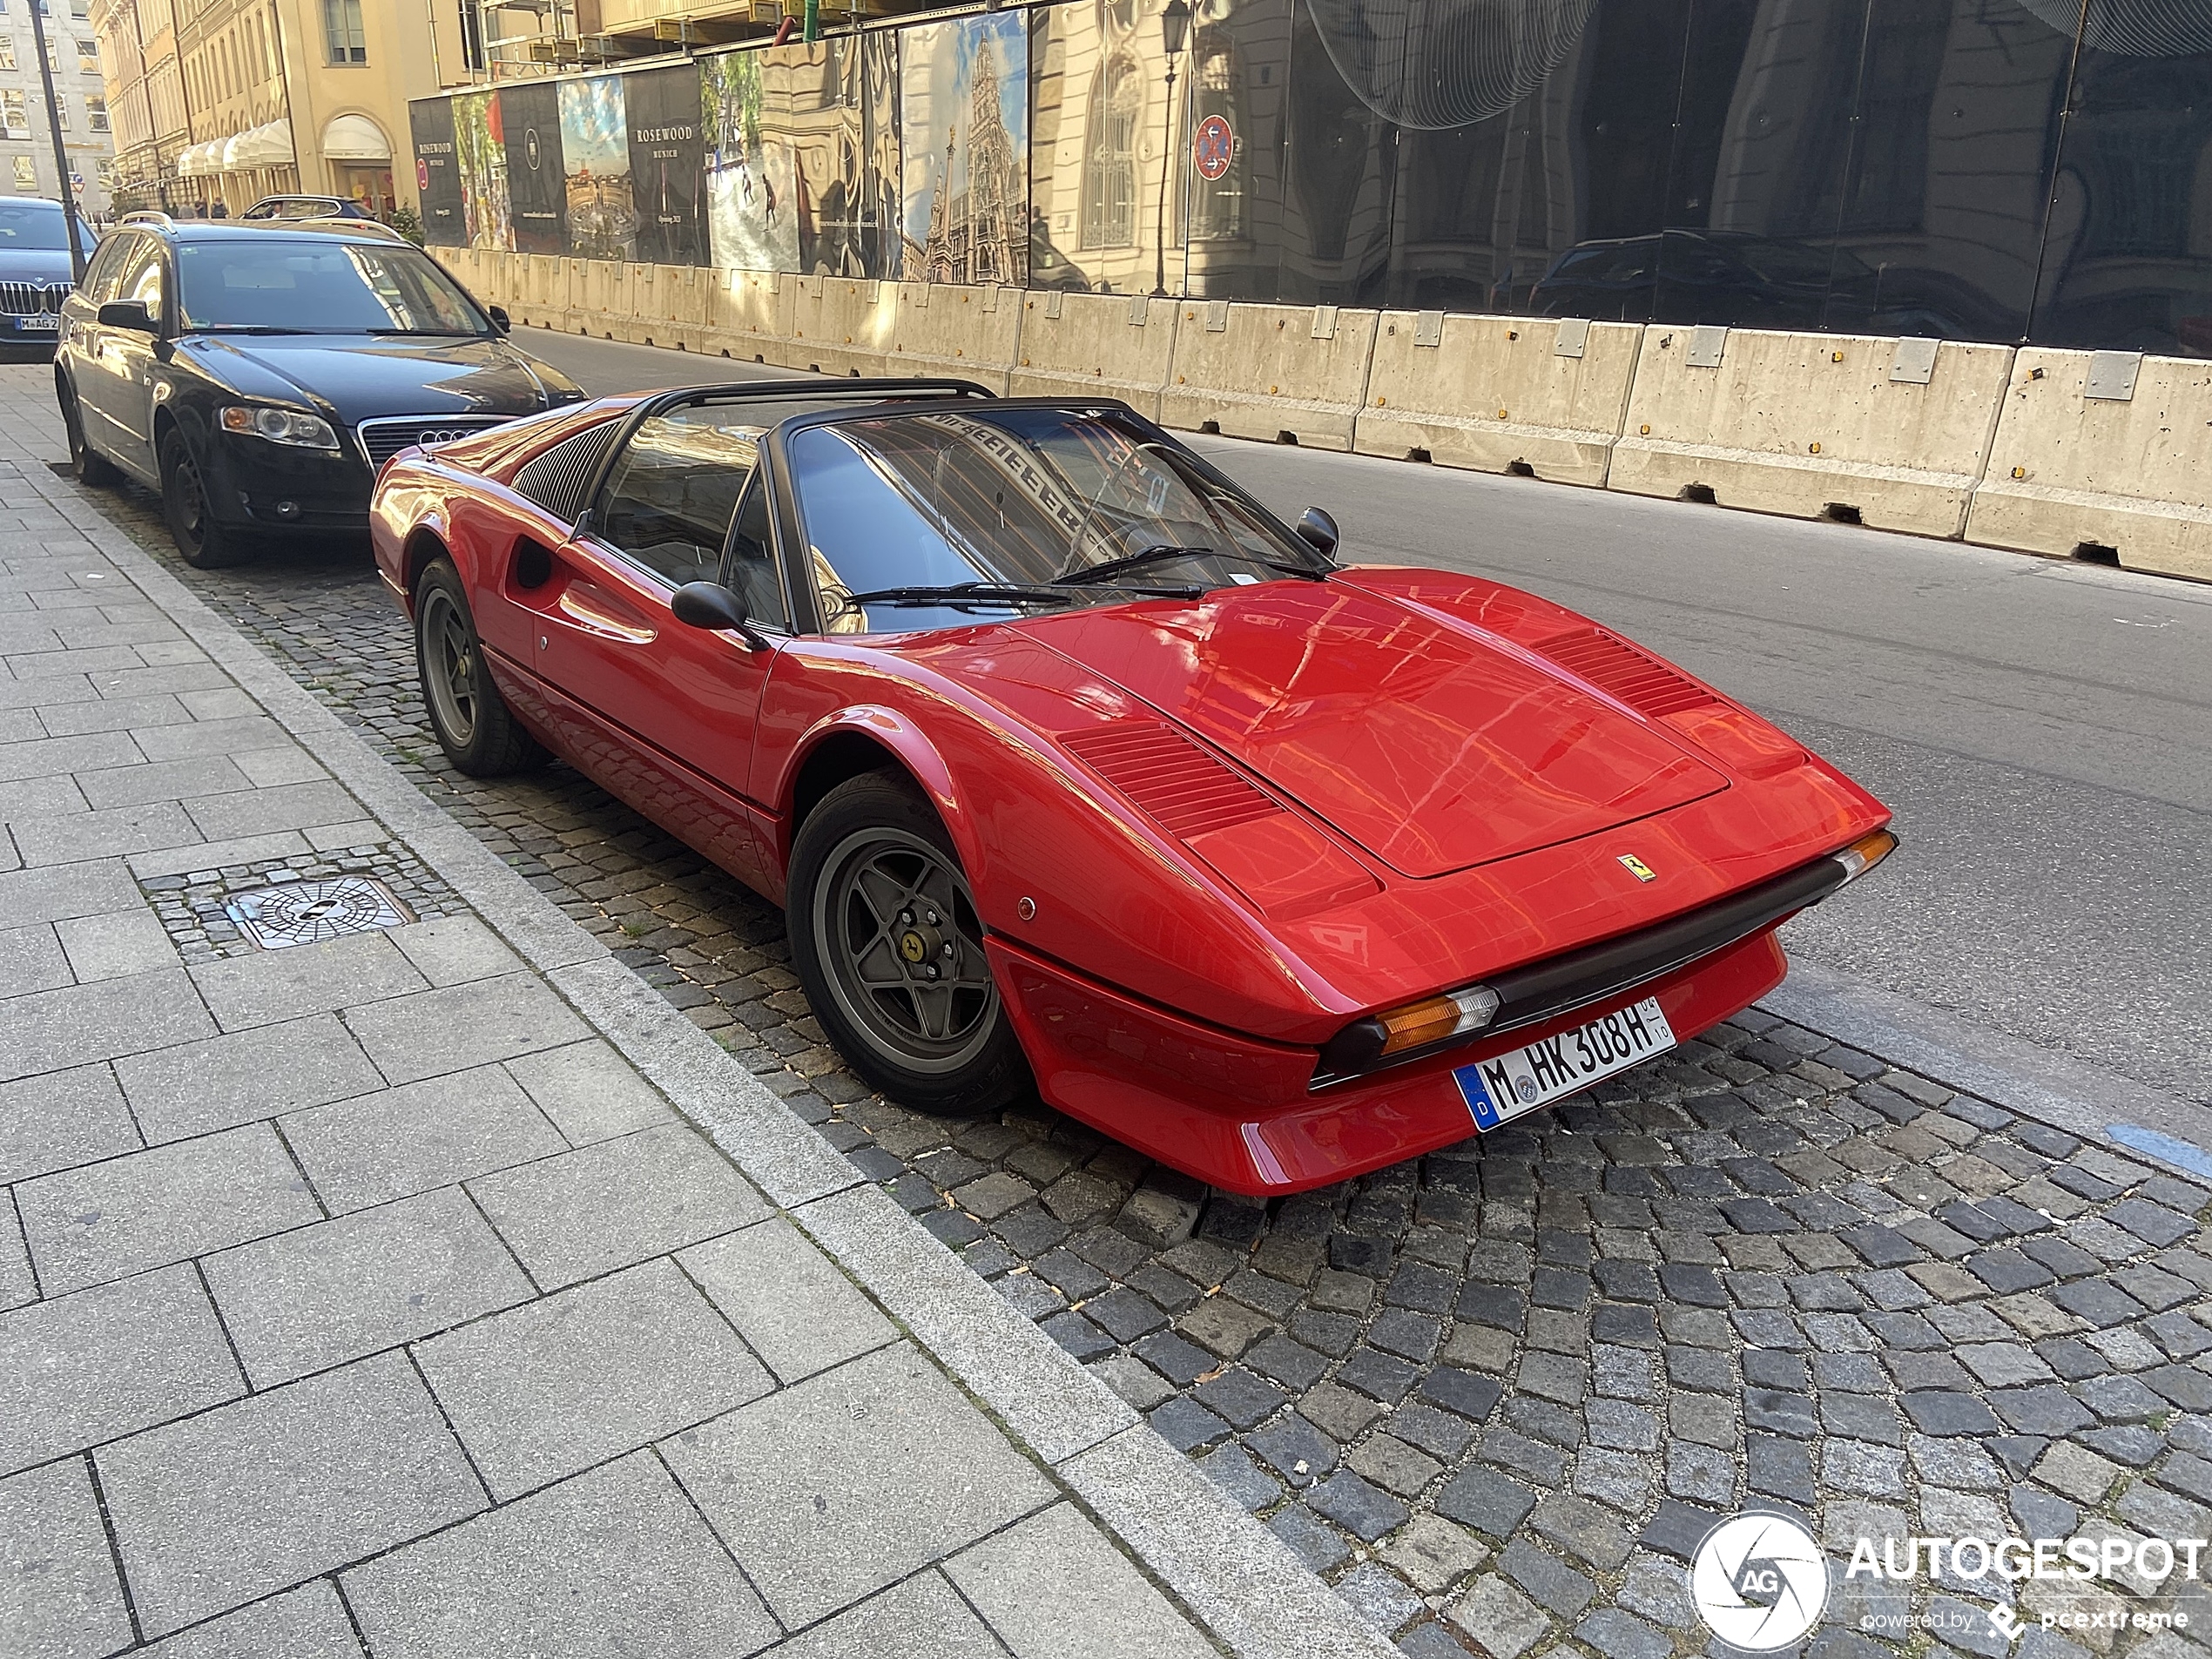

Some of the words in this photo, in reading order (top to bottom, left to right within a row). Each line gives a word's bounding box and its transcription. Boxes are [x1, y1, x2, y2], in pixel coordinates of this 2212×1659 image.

[637, 127, 692, 142] ROSEWOOD
[653, 149, 678, 158] MUNICH
[1655, 1026, 1669, 1040] 10
[1482, 1059, 1518, 1109] M
[1477, 1102, 1488, 1116] D
